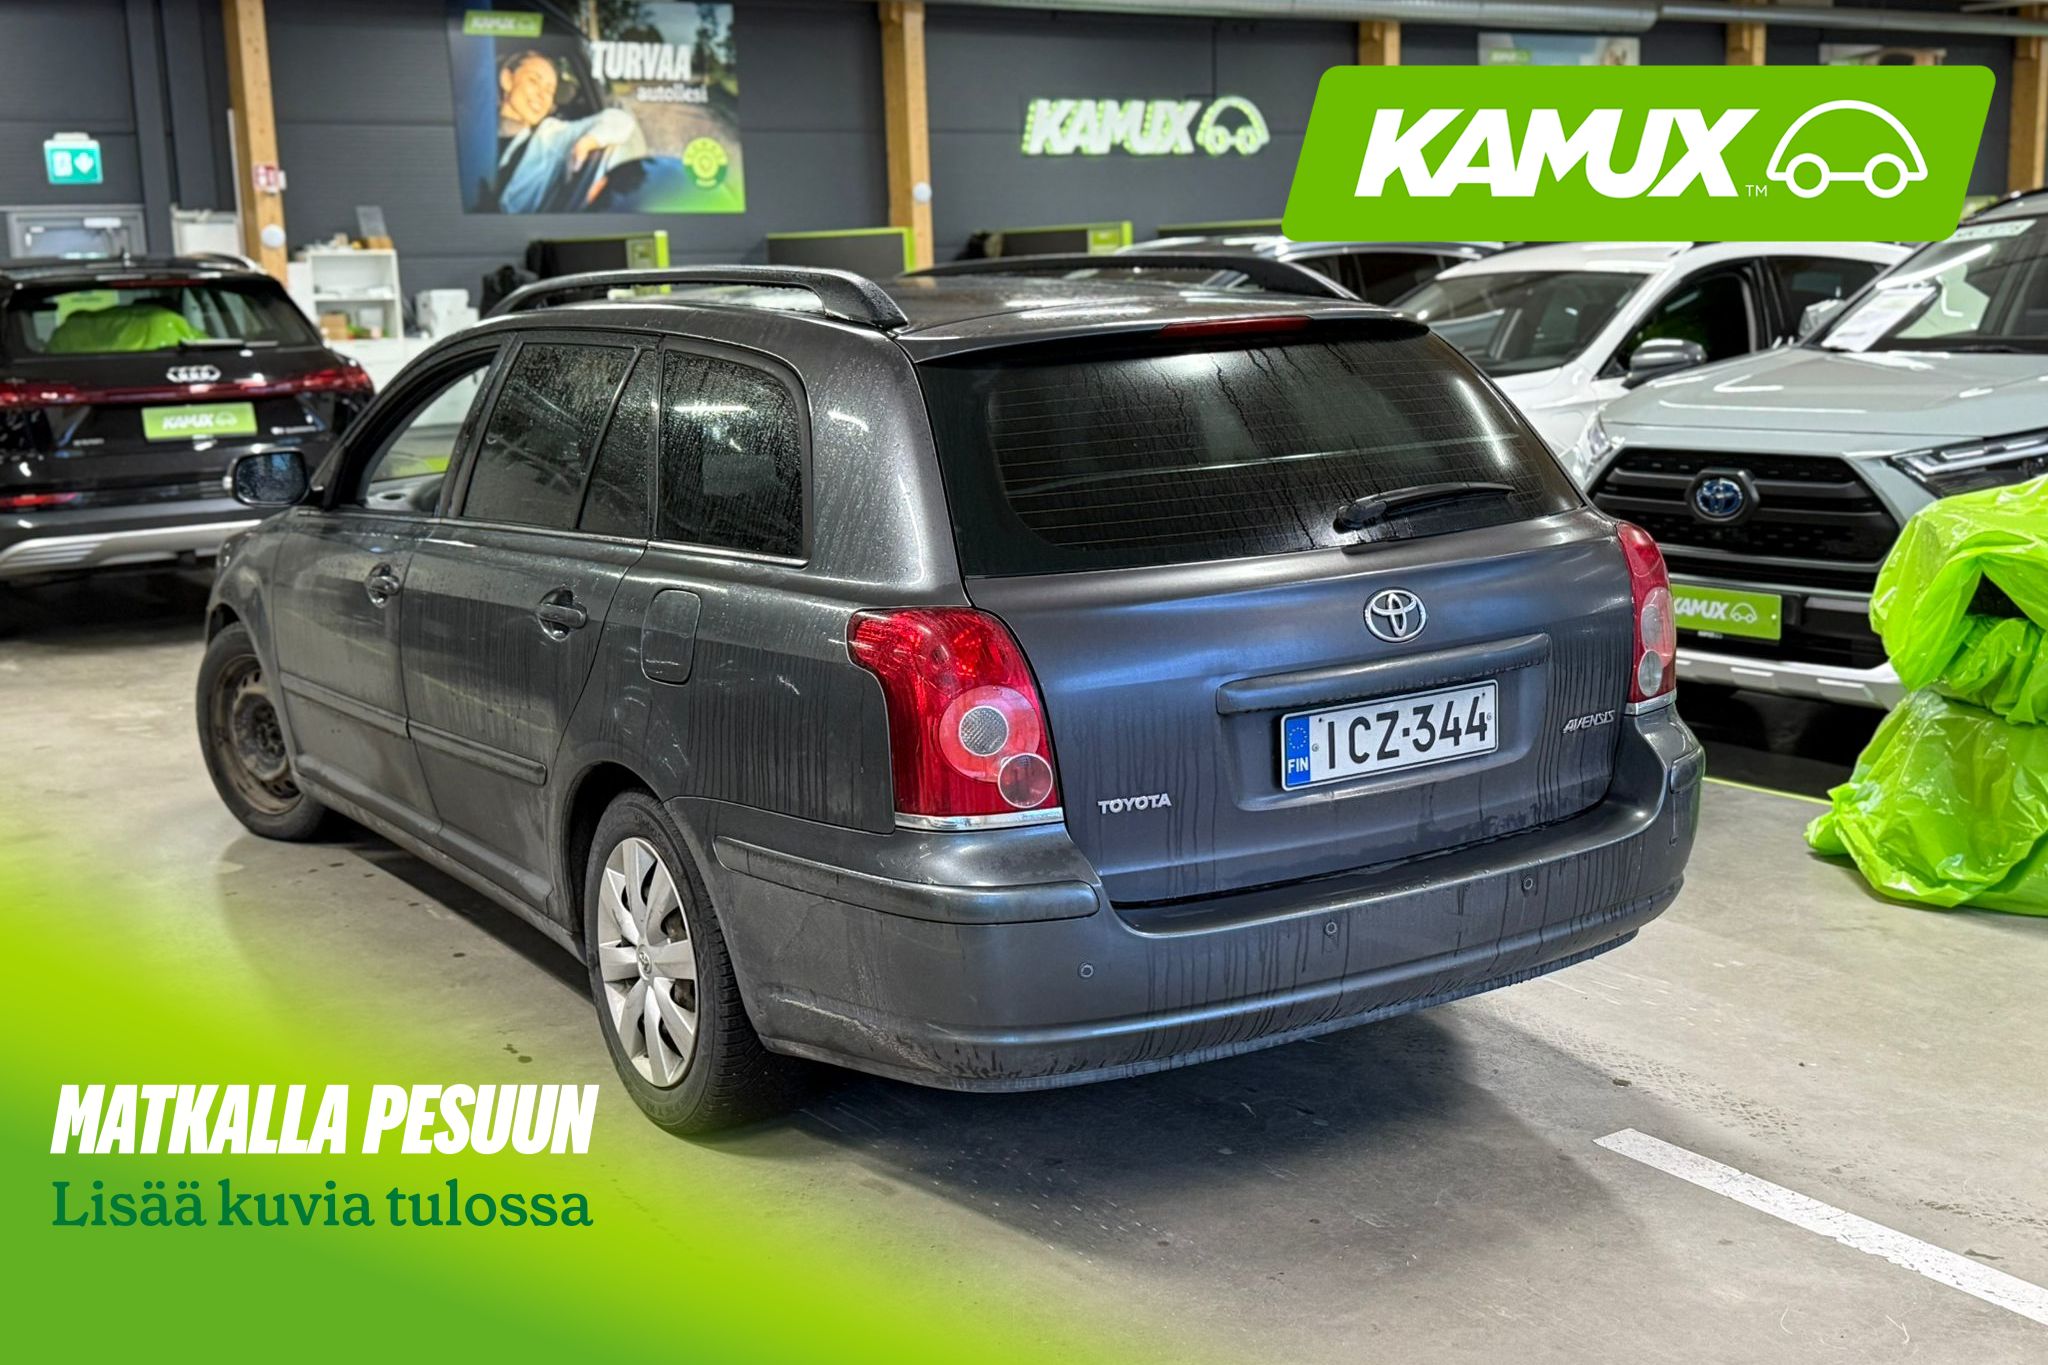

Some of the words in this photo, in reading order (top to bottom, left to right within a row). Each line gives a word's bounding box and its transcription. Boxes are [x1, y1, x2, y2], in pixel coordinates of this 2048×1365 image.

[590, 40, 692, 81] TURVAA
[1021, 98, 1202, 155] KAMUX
[1287, 755, 1309, 774] FIN
[1326, 695, 1488, 770] ICZ-344
[1561, 709, 1616, 734] AVENSIS
[1097, 792, 1172, 815] TOYOTA
